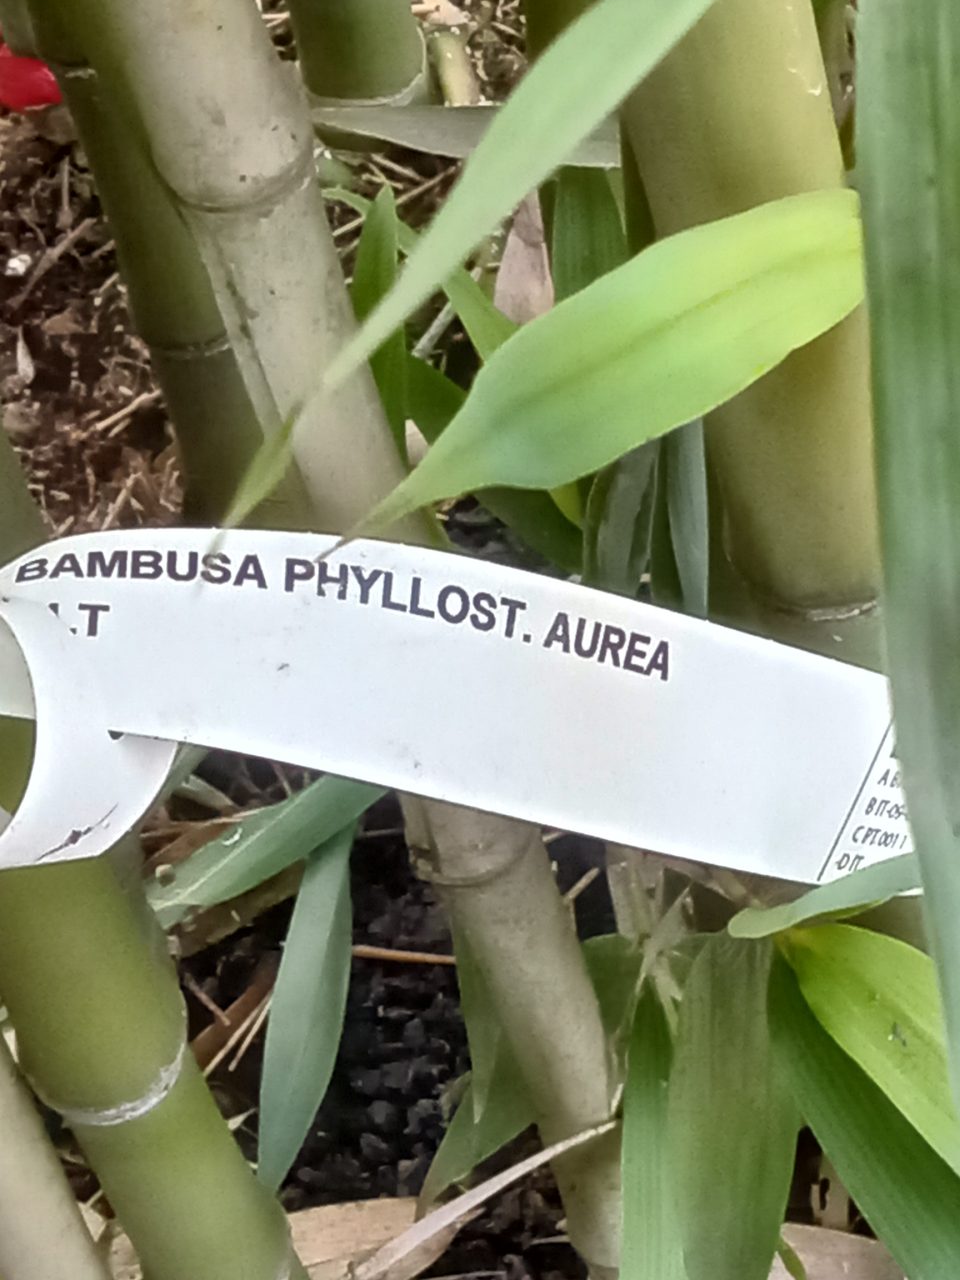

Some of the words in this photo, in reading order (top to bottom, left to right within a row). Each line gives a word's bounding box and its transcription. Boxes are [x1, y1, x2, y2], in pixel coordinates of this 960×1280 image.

[15, 549, 268, 590] BAMBUSA
[284, 558, 531, 643] PHYLLOST.
[543, 612, 670, 681] AUREA
